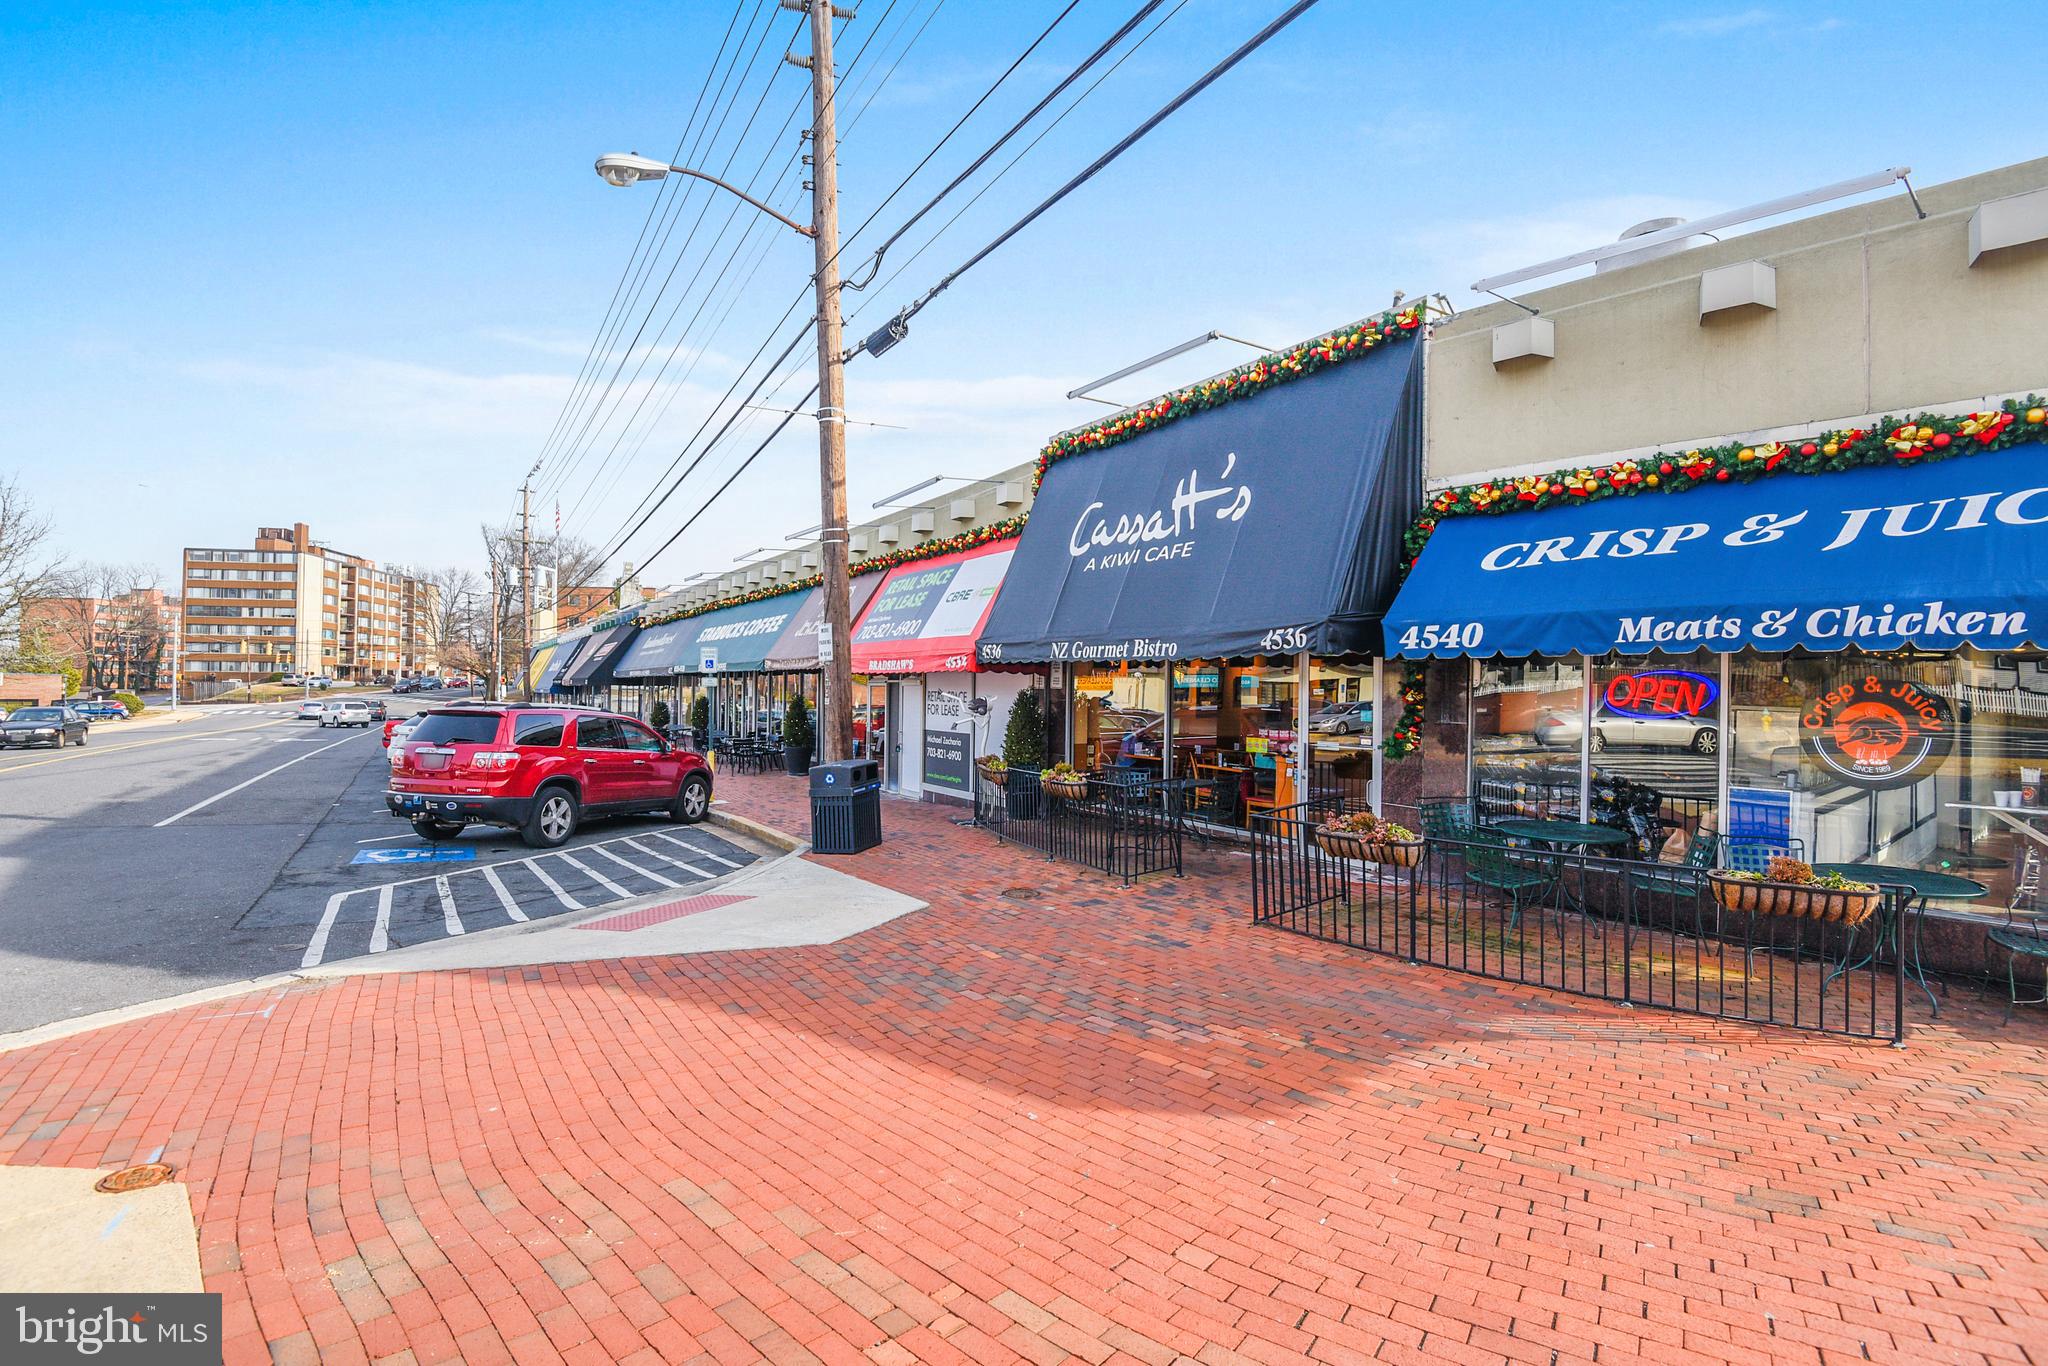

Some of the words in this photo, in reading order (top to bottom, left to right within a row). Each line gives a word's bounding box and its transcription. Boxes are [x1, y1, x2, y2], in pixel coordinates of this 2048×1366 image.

[1480, 523, 1710, 571] CRISP
[1722, 510, 1808, 547] &
[1083, 558, 1096, 572] A
[1100, 549, 1141, 570] KIWI
[1145, 541, 1195, 562] CAFE
[887, 576, 920, 594] RETAIL
[917, 569, 954, 587] SPACE
[875, 597, 897, 612] FOR
[896, 593, 927, 609] LEASE
[945, 589, 973, 603] CBRE
[696, 621, 750, 643] STARBUCKS
[742, 614, 788, 636] COFFEE
[857, 620, 922, 640] 703-821-6900
[1614, 613, 1742, 644] Meats
[1751, 608, 1798, 638] &
[1806, 601, 2029, 638] Chicken
[1261, 626, 1308, 650] 4536
[1399, 622, 1484, 650] 4540
[982, 643, 1002, 659] 4536
[1050, 642, 1069, 659] NZ
[1072, 640, 1129, 659] Gourmet
[1132, 637, 1178, 657] Bistro
[868, 659, 914, 671] BRADSHAW'S
[1607, 674, 1707, 717] OPEN
[1803, 684, 1855, 730] Crisp
[1863, 675, 1882, 693] &
[1890, 682, 1944, 731] Juicy
[927, 703, 940, 715] FOR
[941, 704, 960, 717] LEASE
[927, 747, 962, 761] 703-821-6900
[1851, 764, 1874, 773] SINCE
